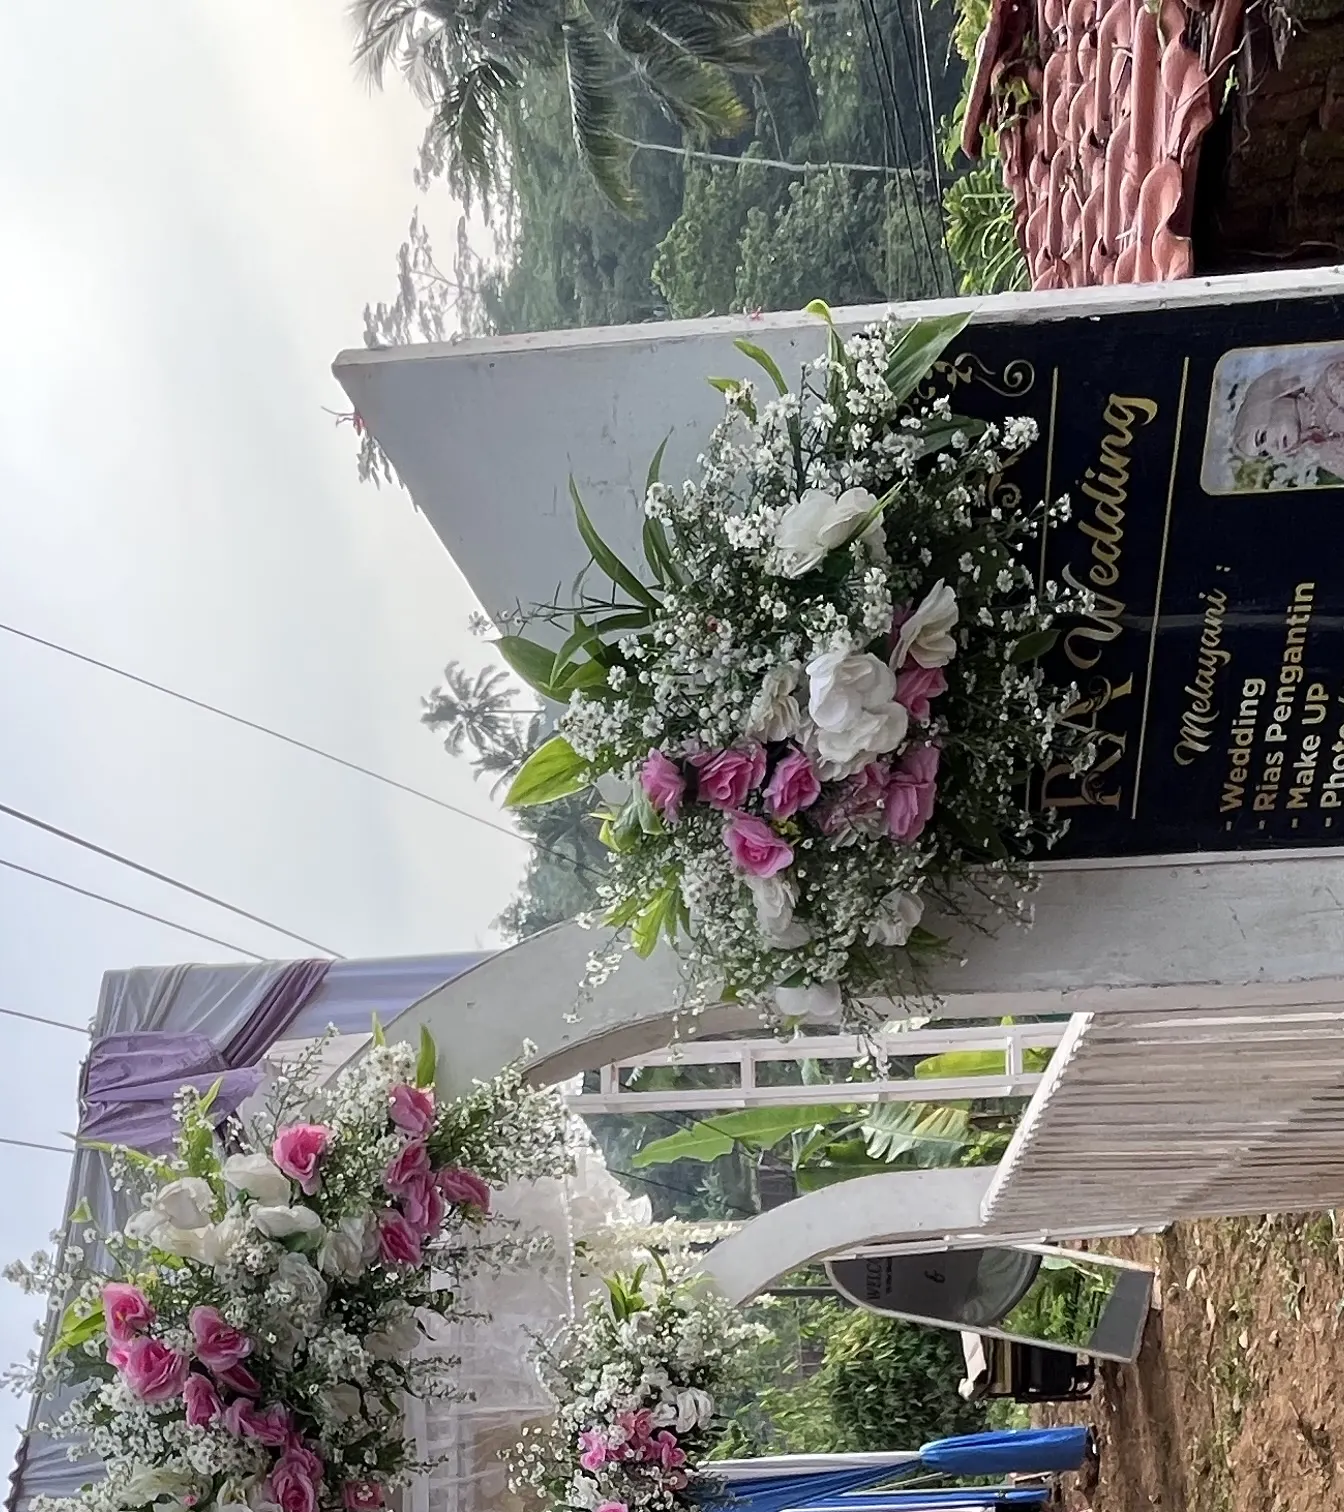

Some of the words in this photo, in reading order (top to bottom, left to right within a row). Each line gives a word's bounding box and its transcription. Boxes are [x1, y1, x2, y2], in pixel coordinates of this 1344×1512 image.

[1061, 392, 1158, 669] Wedding
[1173, 587, 1232, 766] Melayani
[1264, 581, 1316, 743] Pengantin
[1301, 682, 1330, 725] UP
[1219, 677, 1267, 813] Wedding
[1253, 750, 1285, 811] Rias
[1286, 734, 1322, 810] Make
